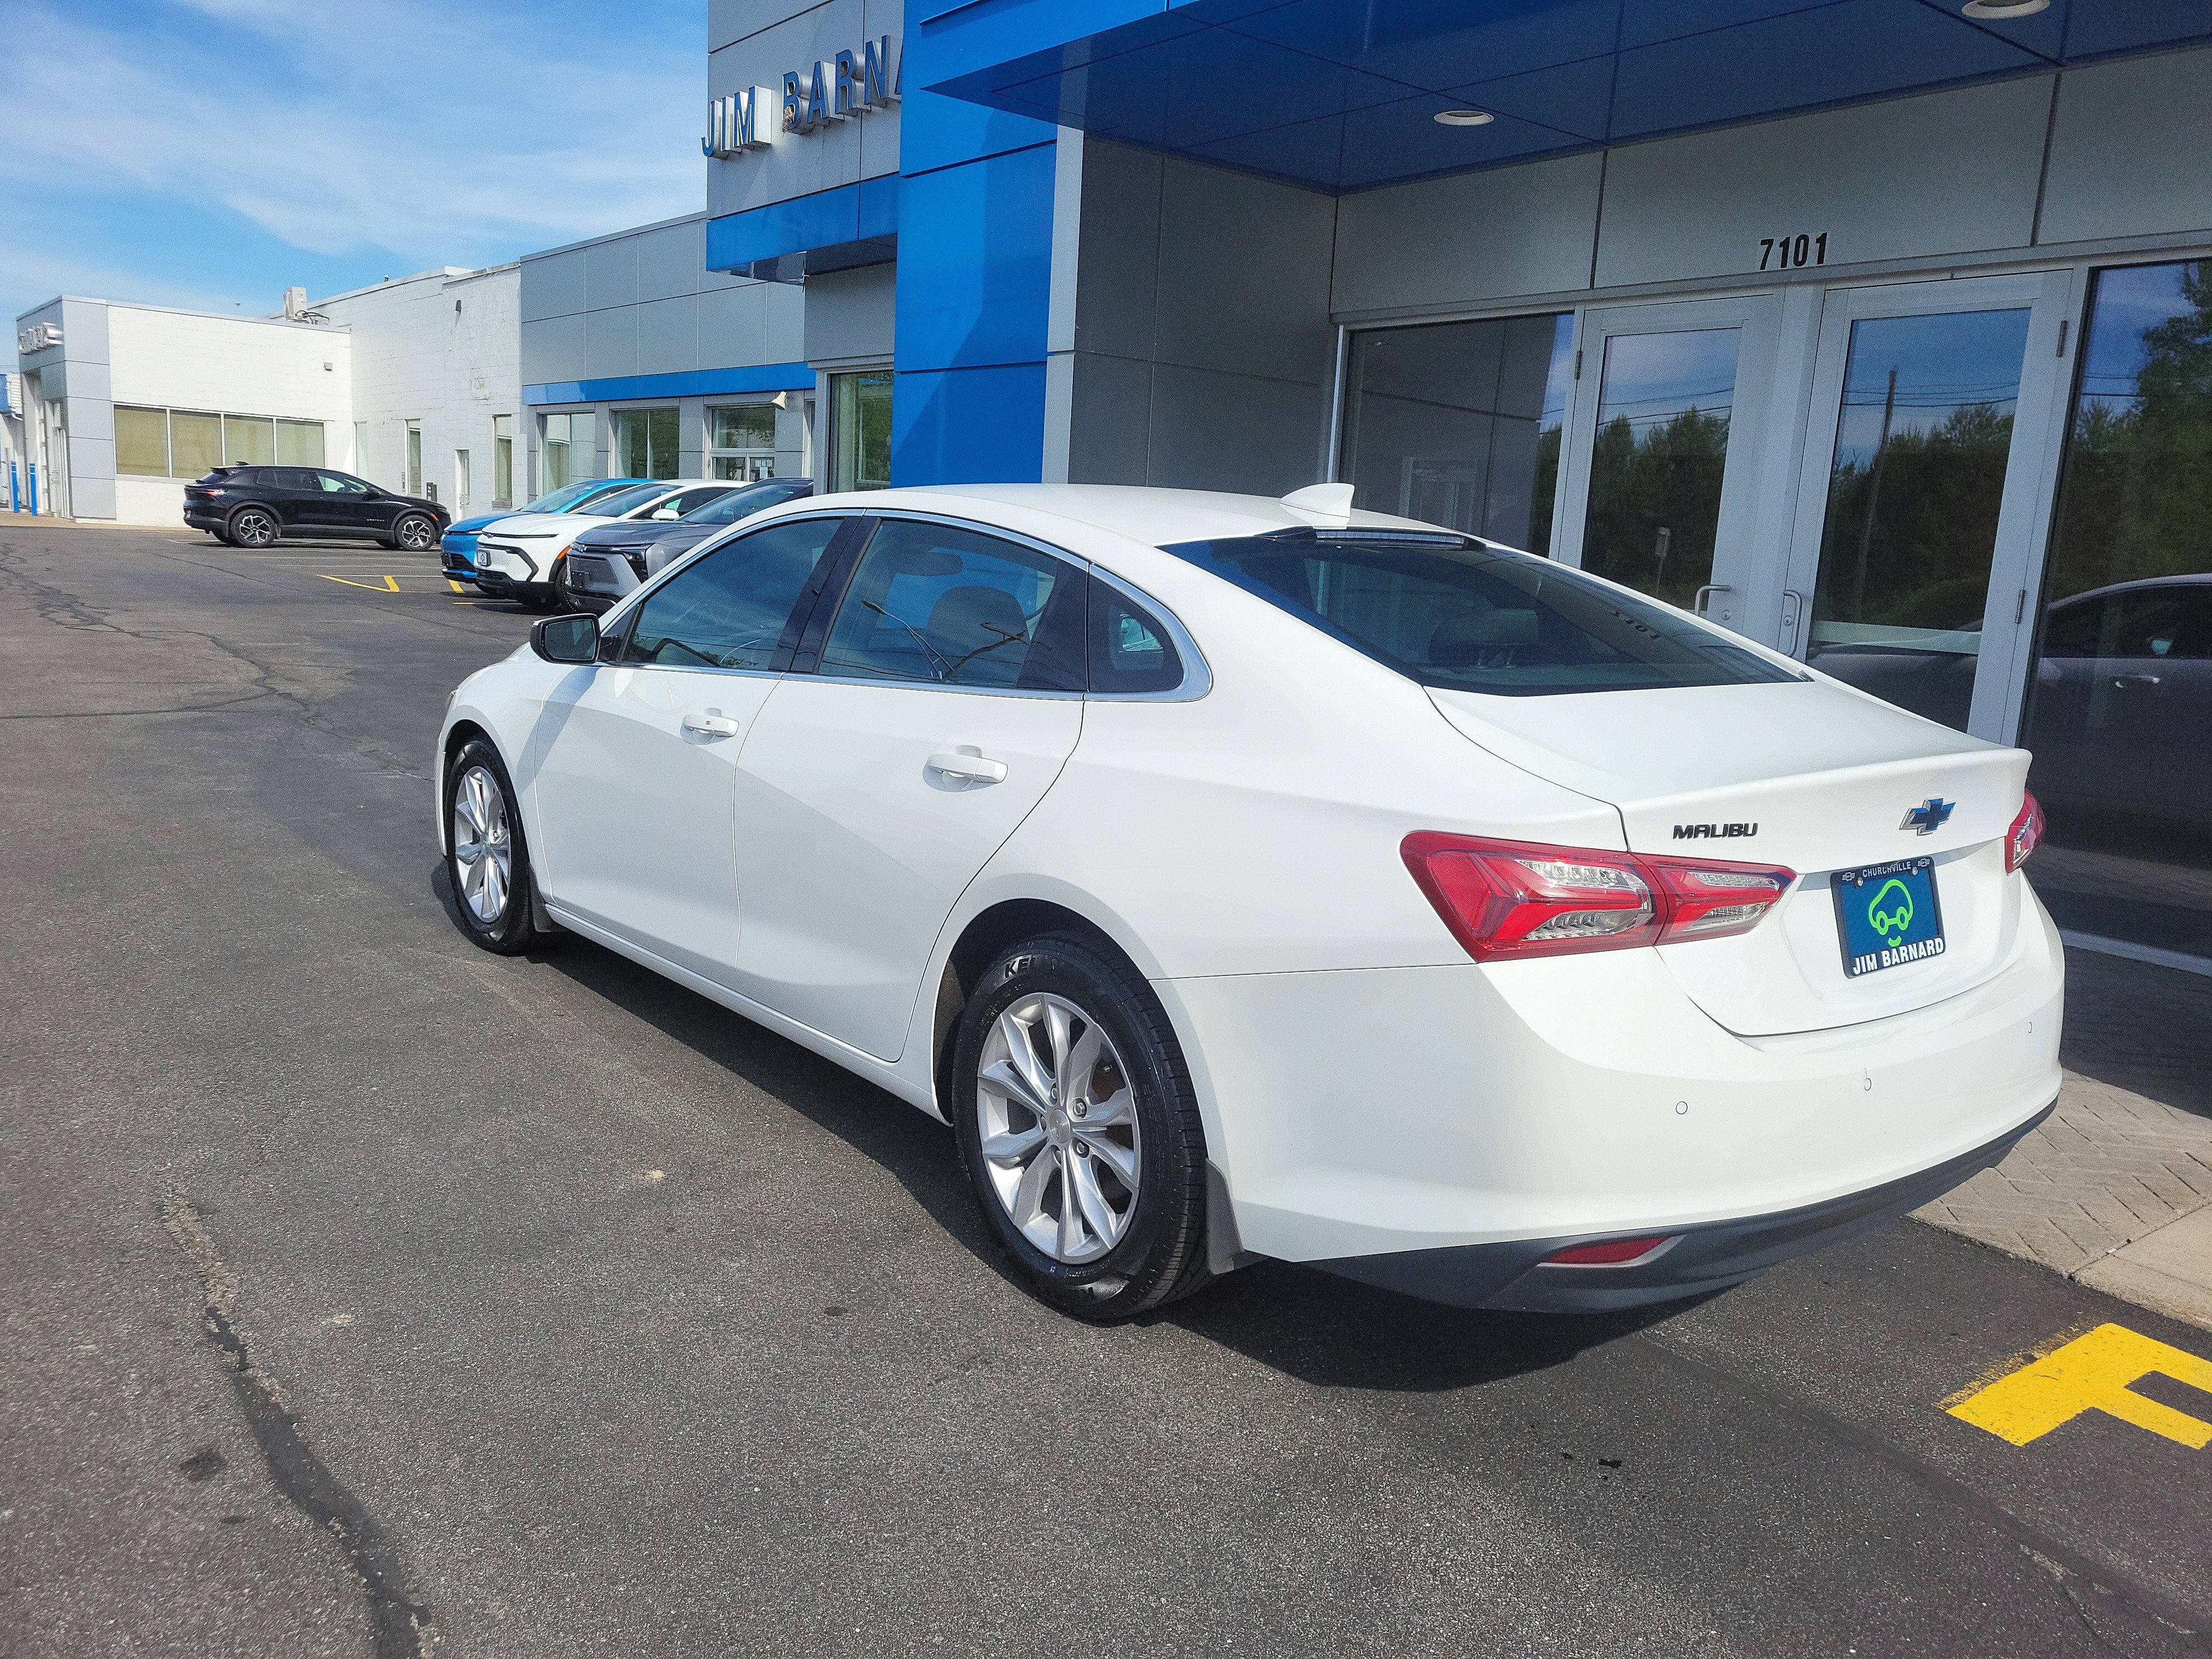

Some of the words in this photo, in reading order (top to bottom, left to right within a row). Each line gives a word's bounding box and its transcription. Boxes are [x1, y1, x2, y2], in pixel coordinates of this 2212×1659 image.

[701, 85, 762, 158] JIM
[781, 34, 902, 133] BARN
[1759, 232, 1828, 270] 7101
[1672, 822, 1759, 839] MALIBU
[1863, 861, 1912, 878] CHURCHVILLE
[1853, 953, 1878, 975] JIM
[1882, 937, 1944, 967] BARNARD
